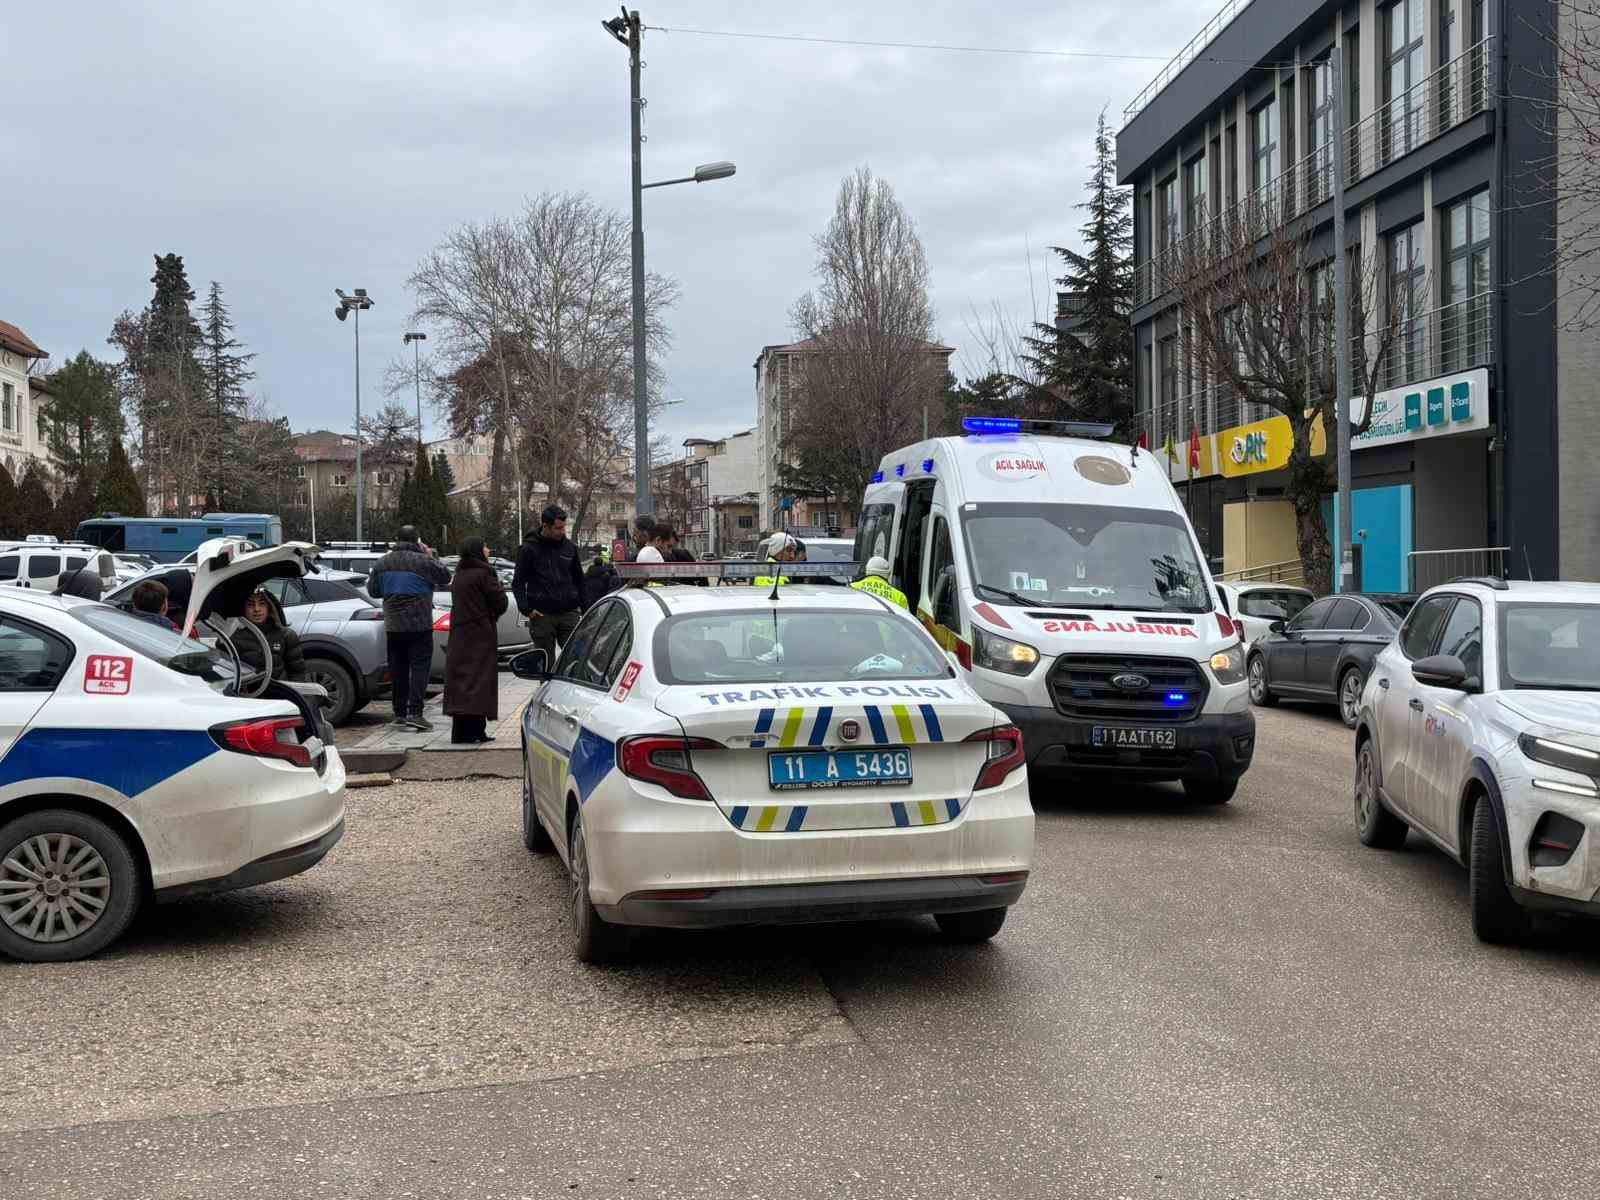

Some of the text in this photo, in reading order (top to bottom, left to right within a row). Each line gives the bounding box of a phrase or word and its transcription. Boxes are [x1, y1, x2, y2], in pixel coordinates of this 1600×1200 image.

[93, 659, 126, 678] 112
[701, 686, 831, 706] TRAFİK
[785, 752, 907, 779] 11 A 5436
